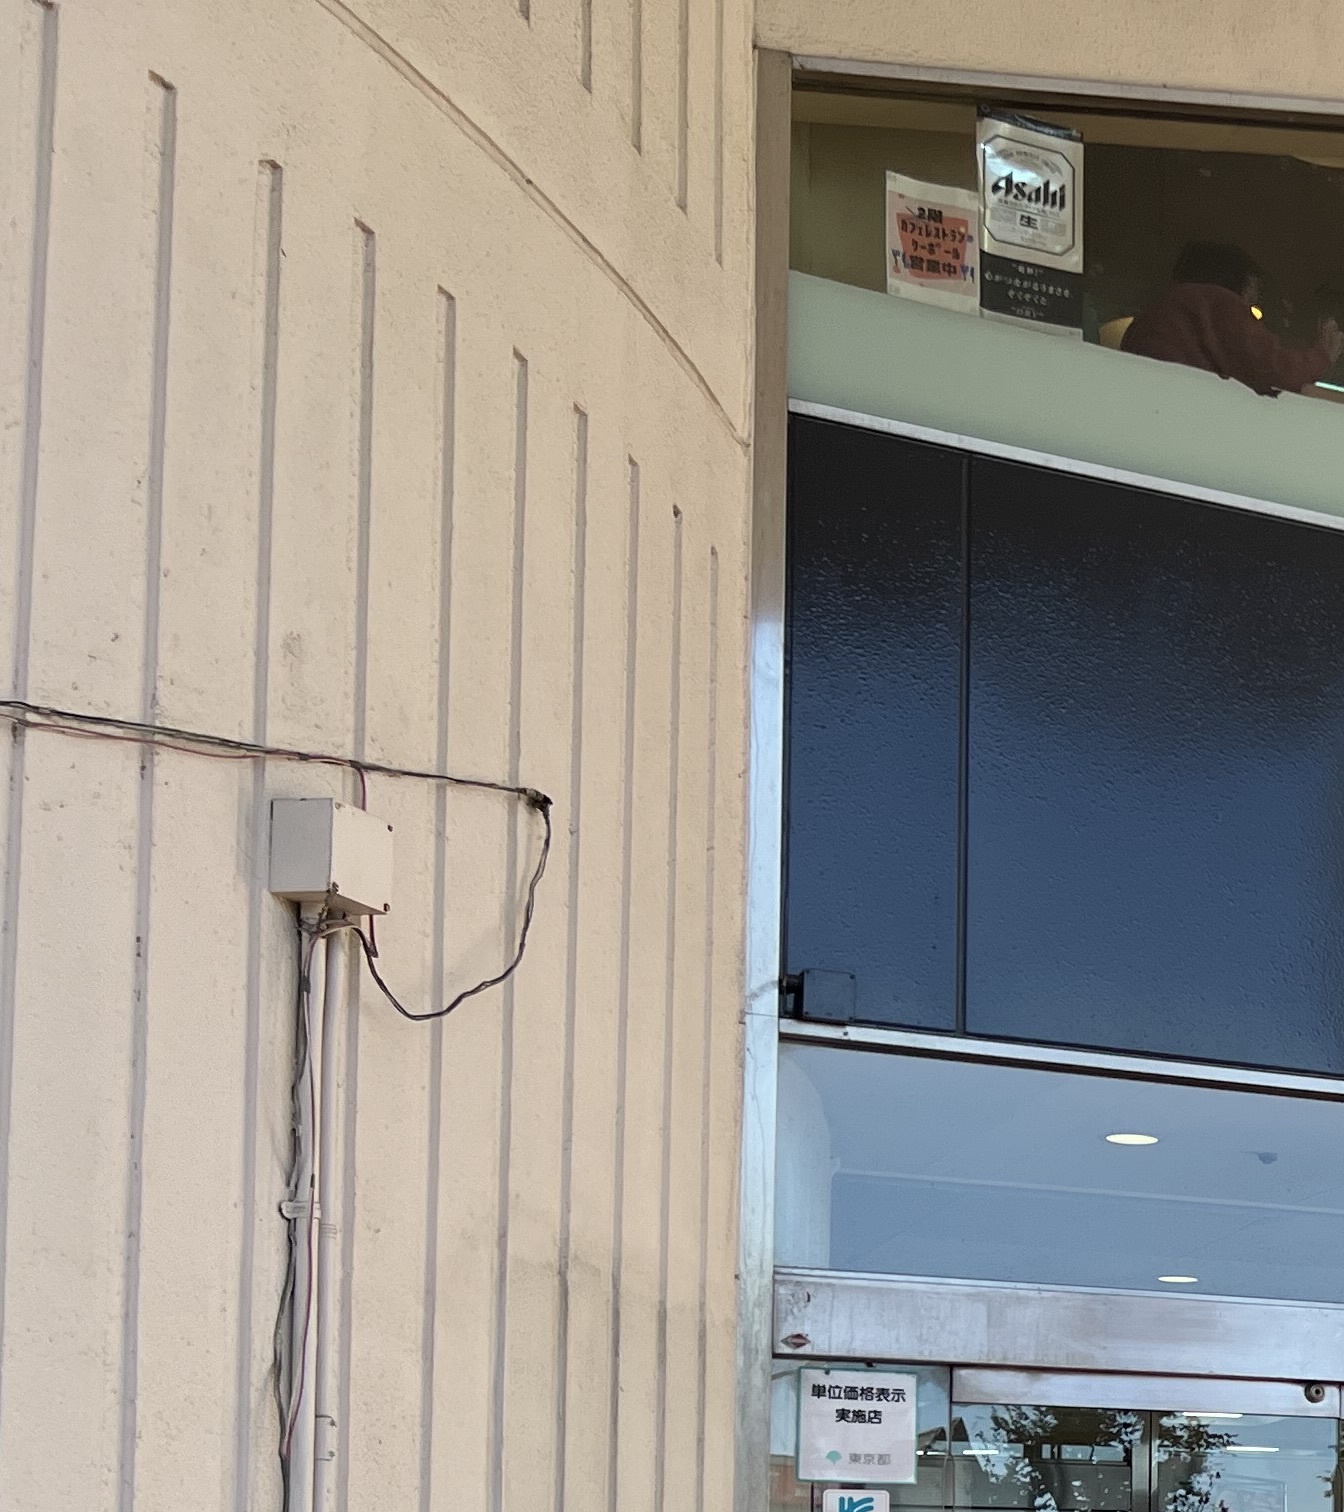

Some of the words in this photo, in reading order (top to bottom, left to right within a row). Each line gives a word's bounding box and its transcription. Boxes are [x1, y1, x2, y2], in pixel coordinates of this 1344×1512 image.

[991, 171, 1066, 212] Asahi
[1019, 214, 1039, 231] 生
[909, 255, 958, 277] 営業中
[811, 1383, 906, 1403] 単位価格表示
[835, 1408, 883, 1425] 実施店
[848, 1453, 891, 1466] 東京都
